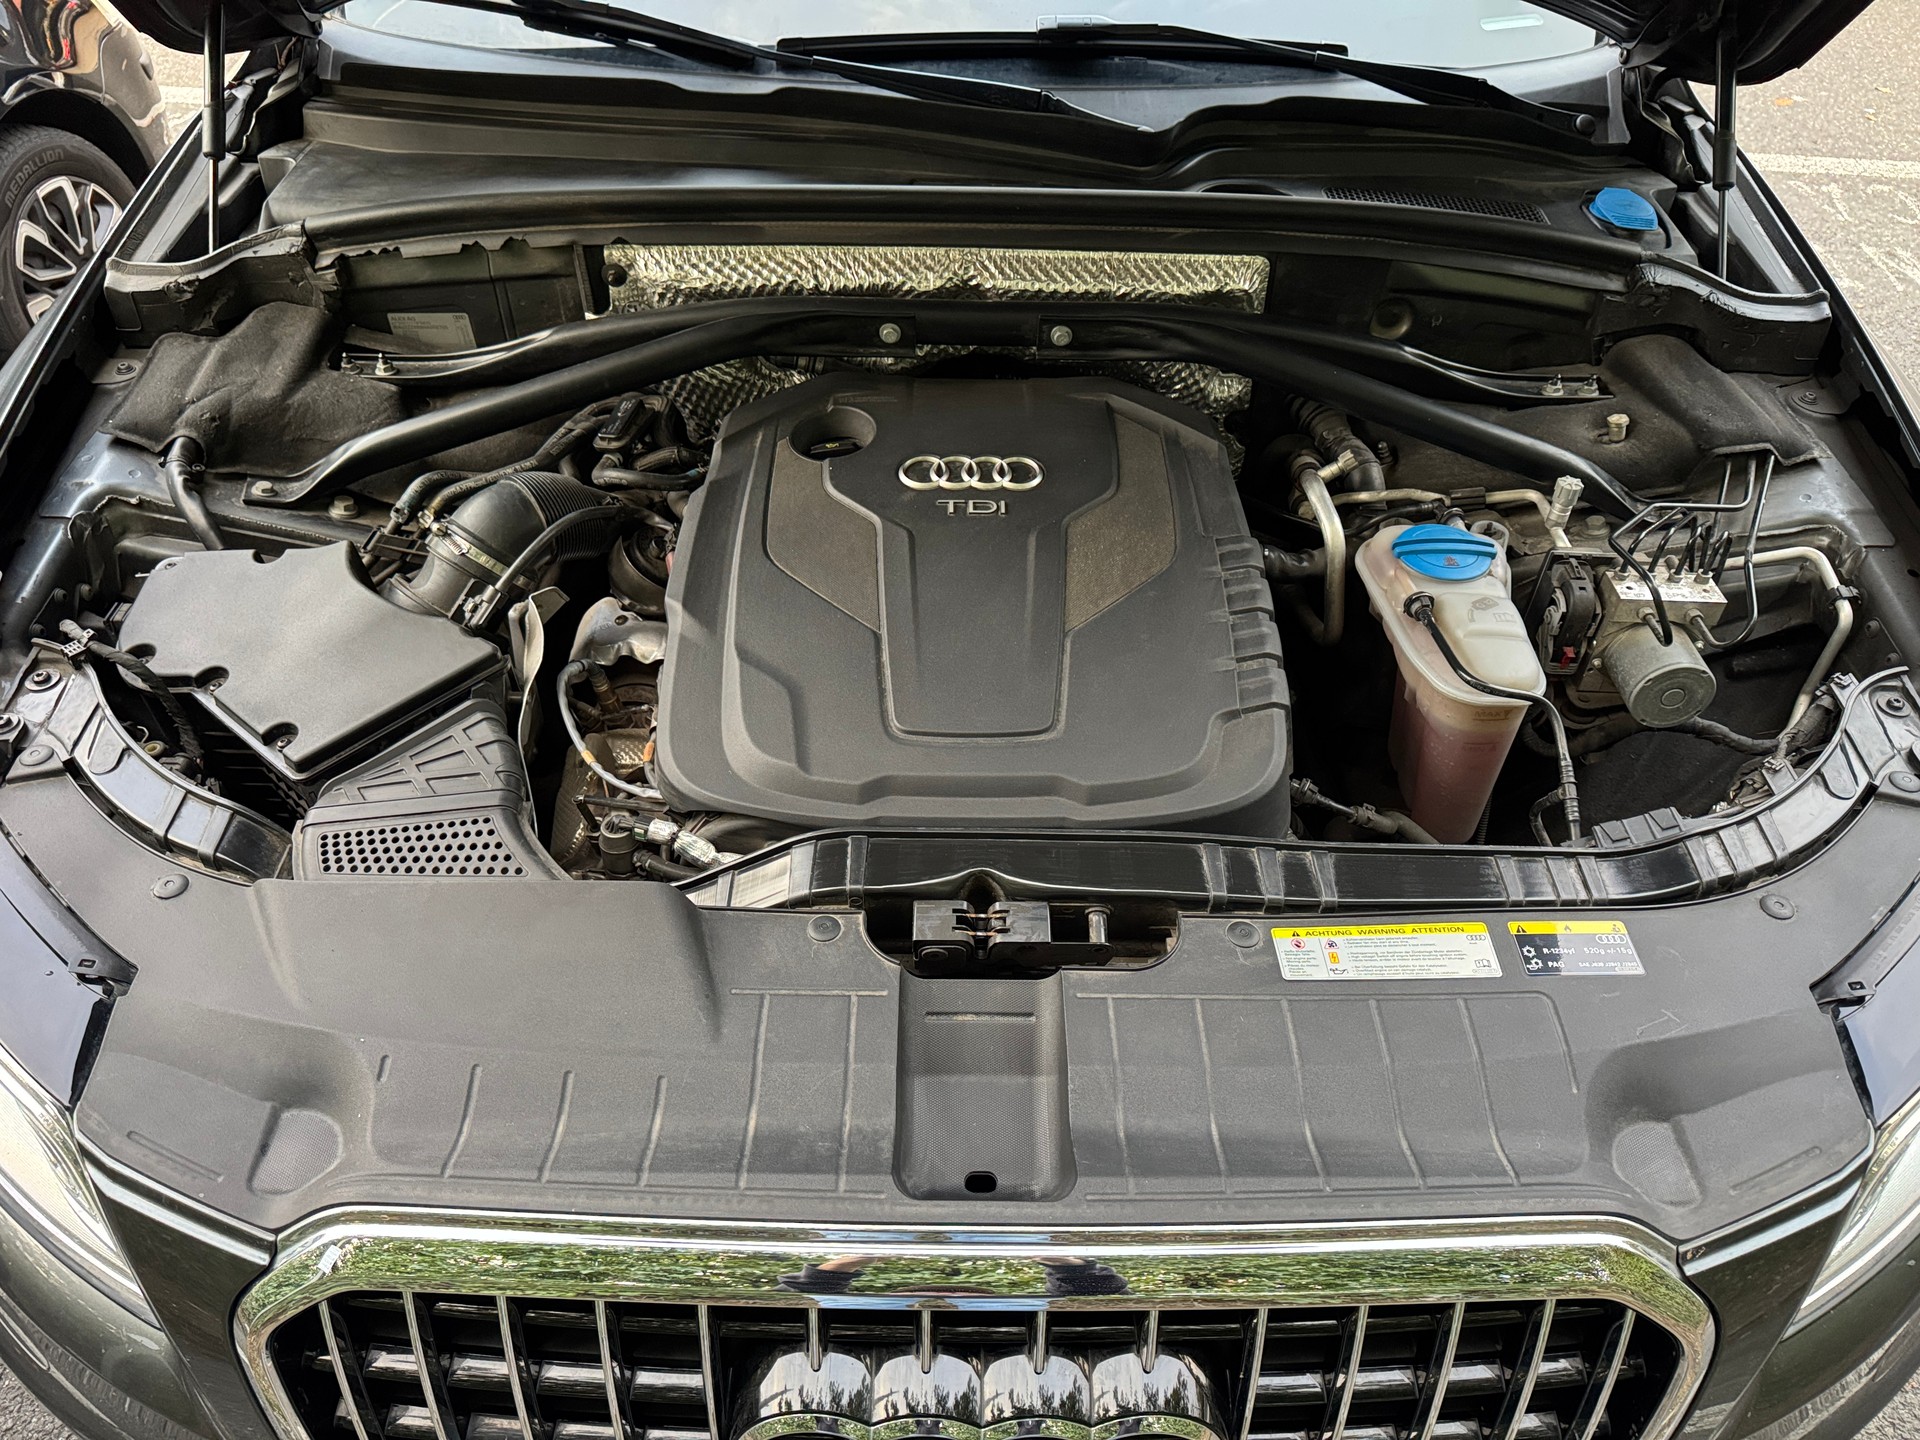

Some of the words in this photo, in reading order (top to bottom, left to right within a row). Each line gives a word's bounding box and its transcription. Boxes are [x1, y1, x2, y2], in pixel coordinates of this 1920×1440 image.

[4, 149, 64, 208] MEDALLION
[936, 499, 1006, 516] TDI
[1357, 928, 1406, 936] WARNING
[1411, 926, 1465, 934] ATTENTION
